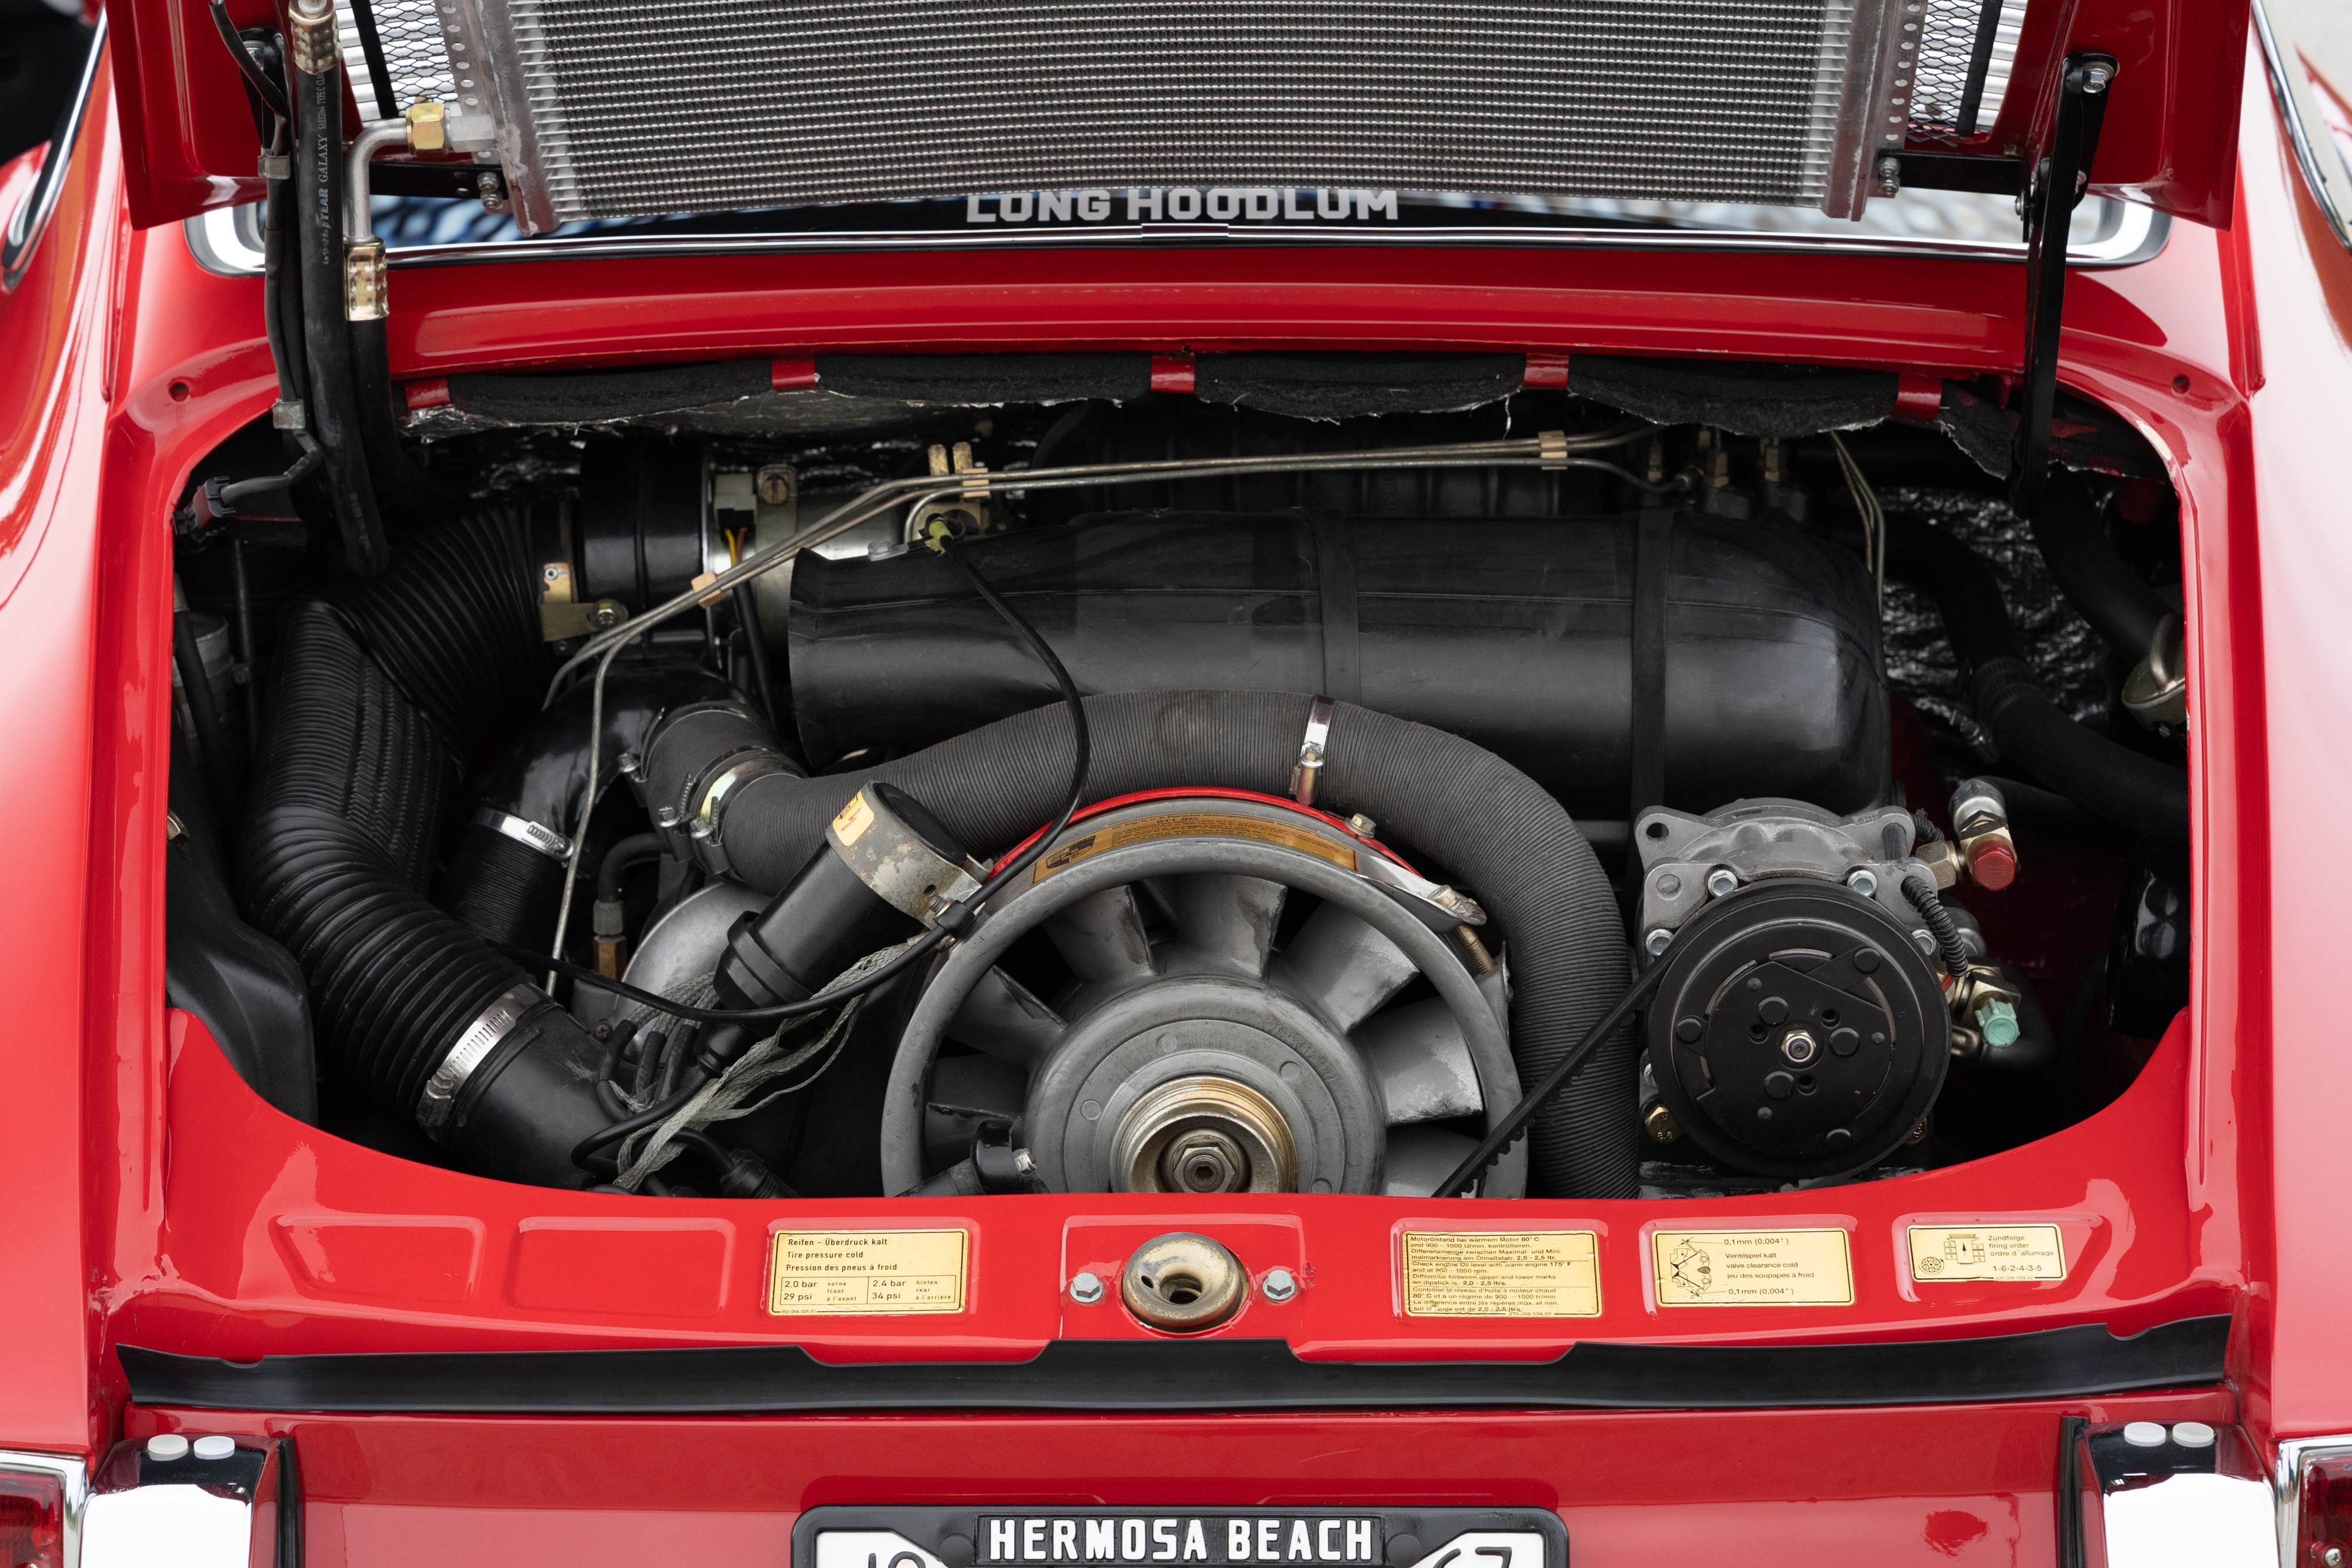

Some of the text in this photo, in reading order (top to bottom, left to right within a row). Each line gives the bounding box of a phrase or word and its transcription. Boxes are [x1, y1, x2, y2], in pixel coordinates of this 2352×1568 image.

[318, 91, 326, 104] TYPE
[318, 134, 328, 182] GALAXY
[966, 187, 1398, 223] LONG HOODLUM
[887, 1292, 901, 1300] psi
[990, 1519, 1372, 1560] HERMOSA BEACH
